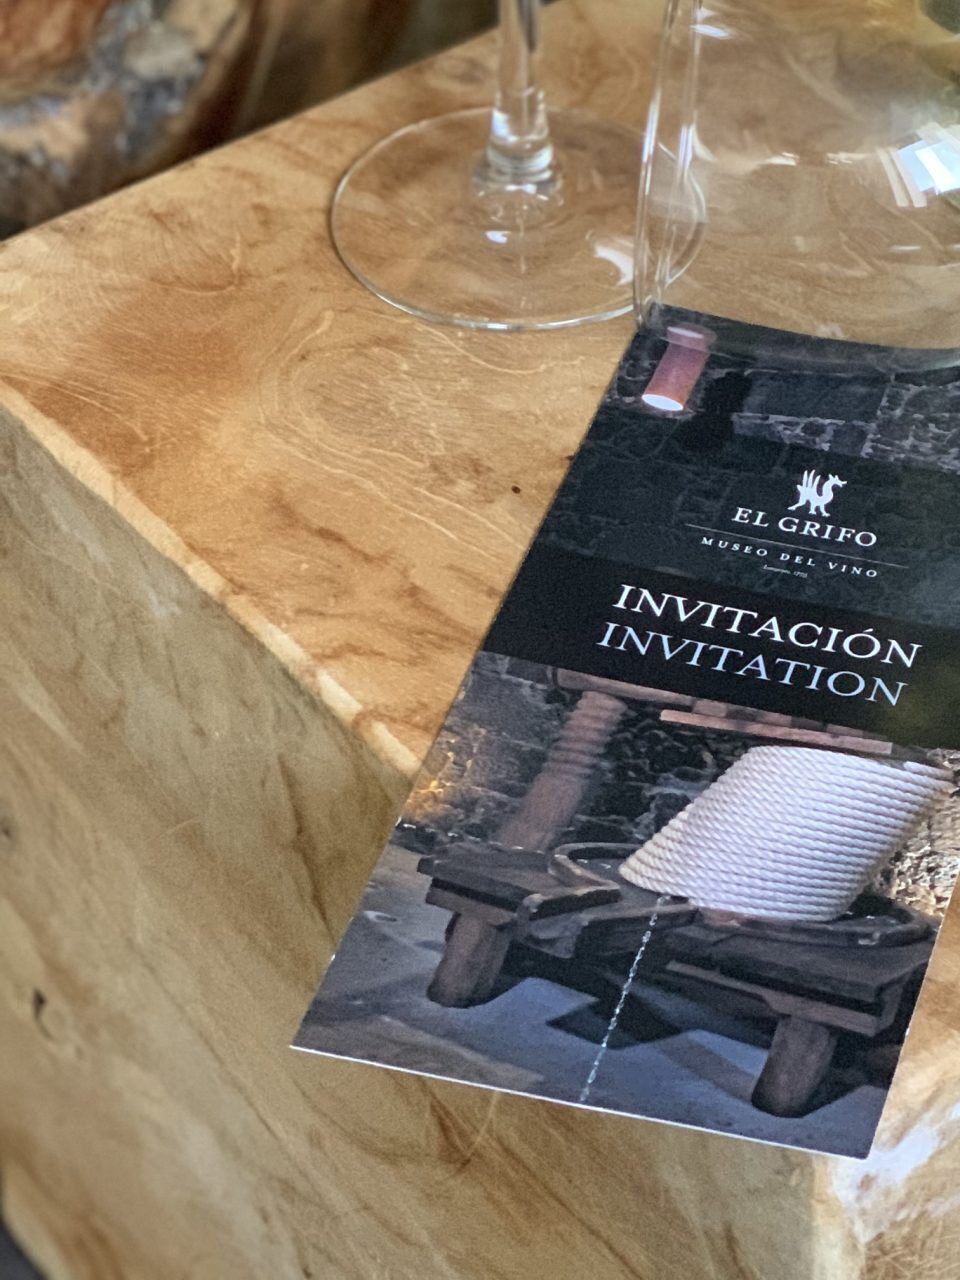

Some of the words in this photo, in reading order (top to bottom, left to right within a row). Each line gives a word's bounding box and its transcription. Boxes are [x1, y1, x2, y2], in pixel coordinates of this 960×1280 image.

[701, 537, 768, 557] MUSEO
[780, 553, 815, 567] DEL
[828, 562, 878, 578] VINO
[732, 507, 769, 527] EL
[778, 516, 877, 547] GRIFO
[611, 584, 922, 668] INVITACIÓN
[597, 622, 908, 706] INVITATION
